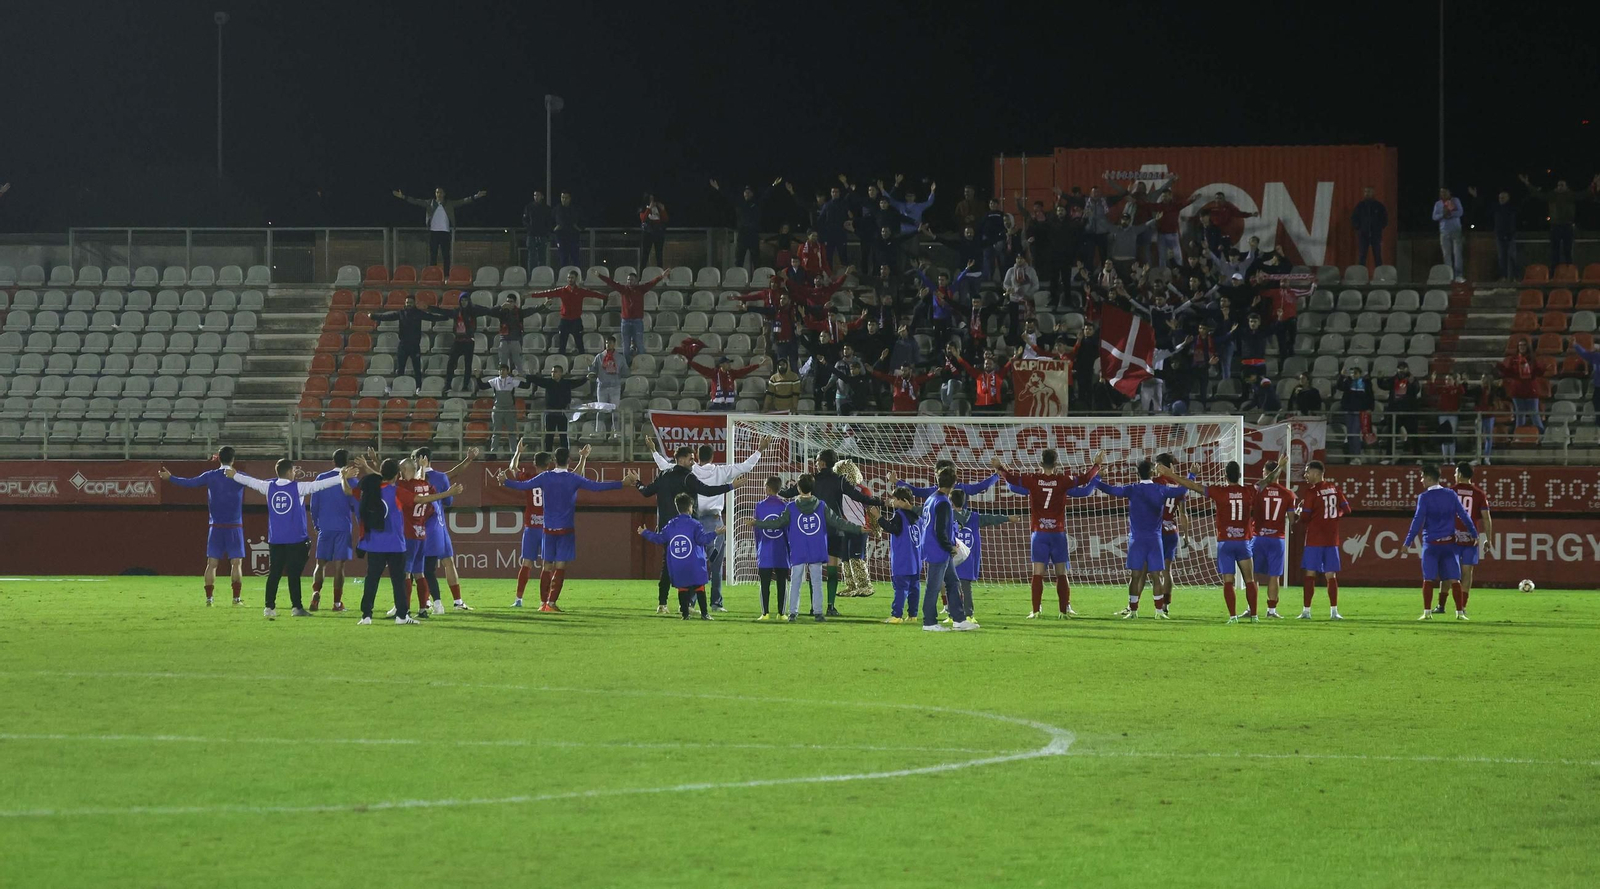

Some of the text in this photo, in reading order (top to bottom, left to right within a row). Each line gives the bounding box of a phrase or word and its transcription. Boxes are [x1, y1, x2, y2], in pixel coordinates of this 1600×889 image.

[1013, 360, 1065, 371] CAPITAN
[658, 427, 727, 441] KOMAN
[0, 481, 59, 494] OPLAGA
[84, 481, 156, 494] COPLAGA
[532, 487, 543, 507] 8
[1042, 488, 1053, 509] 7
[1165, 497, 1176, 514] 4
[1361, 499, 1416, 507] tendencia
[1229, 500, 1243, 521] 11
[1263, 497, 1283, 521] 17
[1322, 495, 1338, 519] 18
